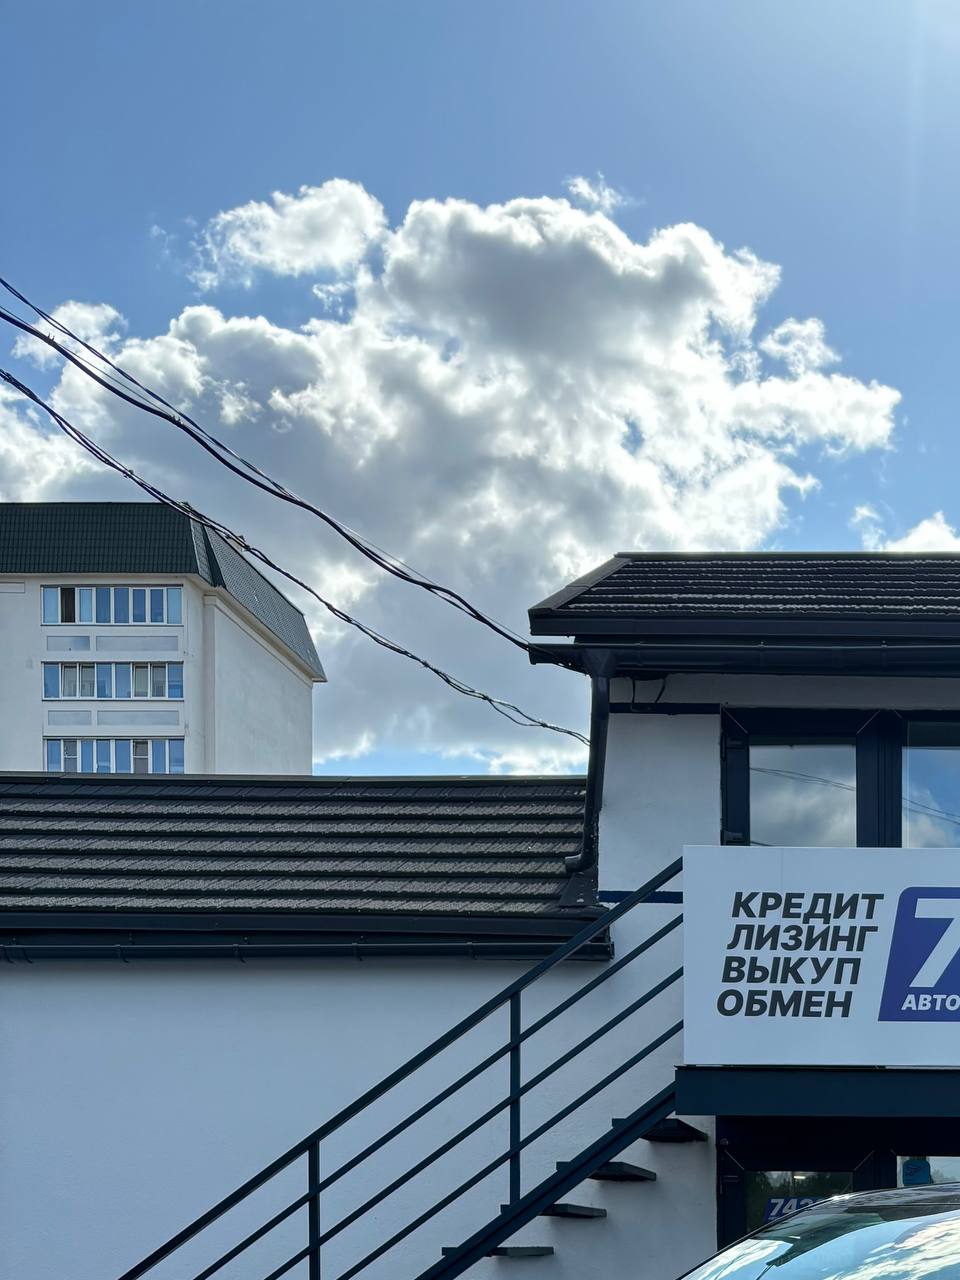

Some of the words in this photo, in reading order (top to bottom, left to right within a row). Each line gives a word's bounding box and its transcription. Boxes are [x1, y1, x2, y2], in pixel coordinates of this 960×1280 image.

[731, 891, 885, 925] КРЕДИТ
[726, 923, 879, 952] ЛИЗИНГ
[721, 955, 862, 985] ВЫКУП
[716, 988, 853, 1018] ОБМЕН
